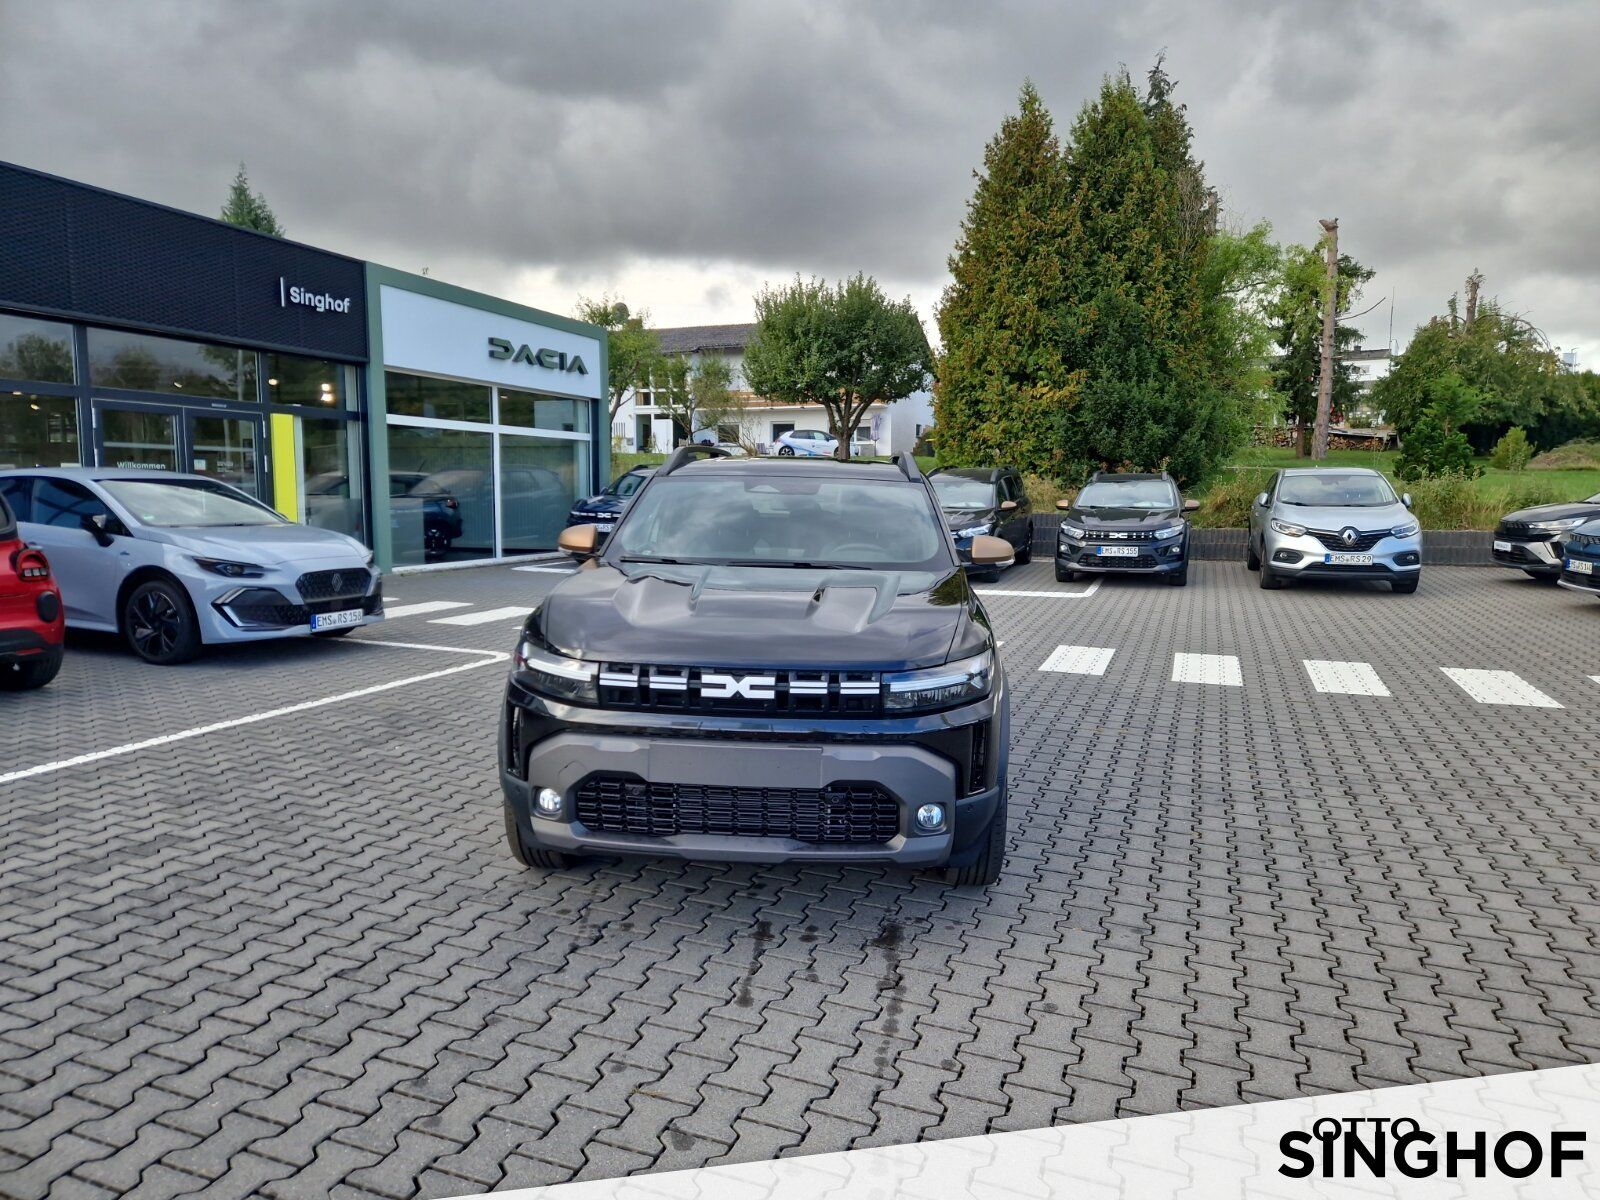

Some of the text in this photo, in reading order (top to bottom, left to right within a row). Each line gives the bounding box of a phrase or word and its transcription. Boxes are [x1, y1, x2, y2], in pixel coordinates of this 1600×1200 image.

[289, 286, 350, 314] Singhof
[488, 337, 589, 375] DACIA
[117, 461, 166, 470] Willkommen
[1329, 554, 1372, 563] EMS RS 29
[316, 614, 332, 627] EMS
[337, 613, 348, 624] RS
